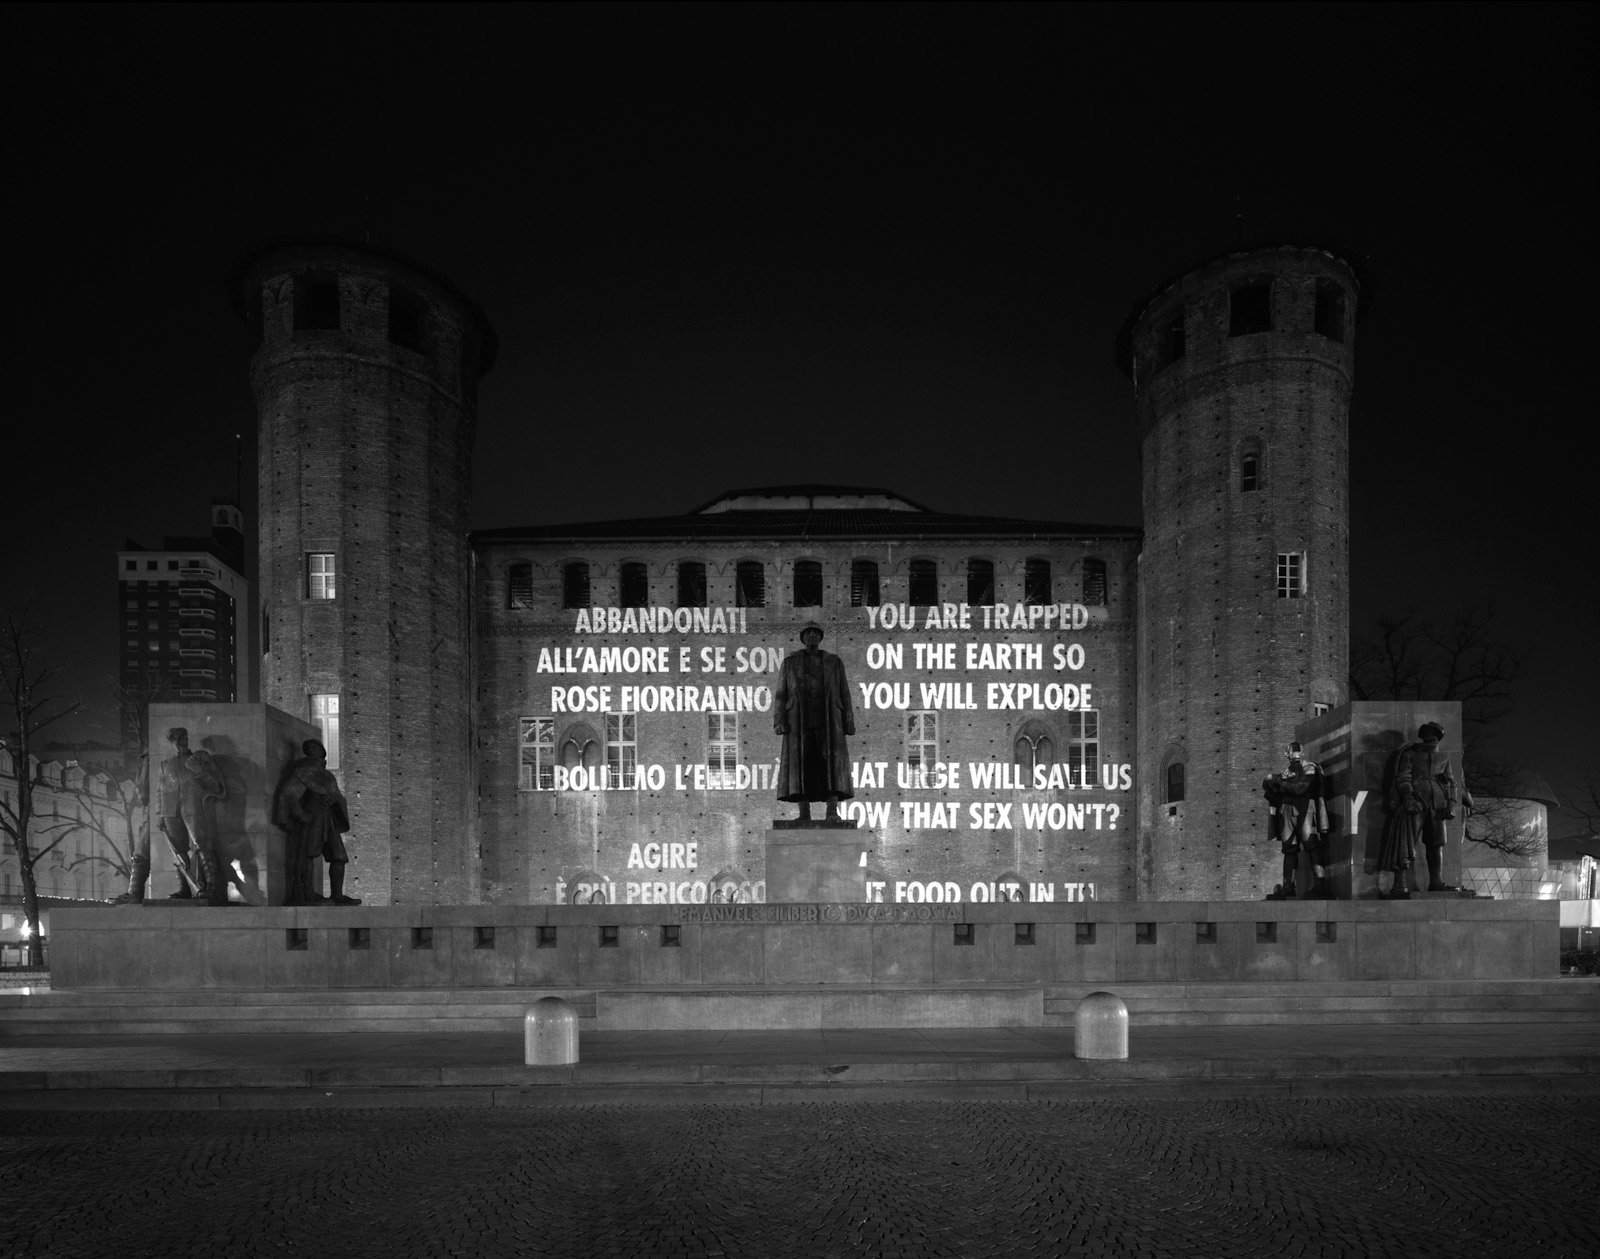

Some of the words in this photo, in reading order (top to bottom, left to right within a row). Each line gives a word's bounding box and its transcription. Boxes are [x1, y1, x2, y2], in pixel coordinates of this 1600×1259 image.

[575, 607, 746, 633] ABBANDONATI
[865, 603, 916, 629] YOU
[925, 603, 971, 629] ARE
[980, 604, 1089, 629] TRAPPED
[537, 646, 670, 673] ALL'AMORE
[680, 647, 691, 672] E
[701, 647, 726, 672] SE
[867, 643, 902, 669] ON
[913, 643, 956, 669] THE
[966, 643, 1042, 669] EARTH
[1053, 644, 1085, 670] SO
[551, 686, 611, 712] ROSE
[621, 686, 772, 712] FIORIRANNO
[859, 683, 910, 709] YOU
[920, 683, 976, 710] WILL
[987, 683, 1092, 711] EXPLODE
[969, 763, 1025, 789] WILL
[1103, 764, 1132, 790] US
[900, 802, 960, 828] THAT
[970, 802, 1012, 829] SEX
[1022, 803, 1120, 830] WON'T?
[627, 843, 697, 869] AGIRE
[896, 881, 961, 903] FOOD
[1029, 883, 1054, 902] IN
